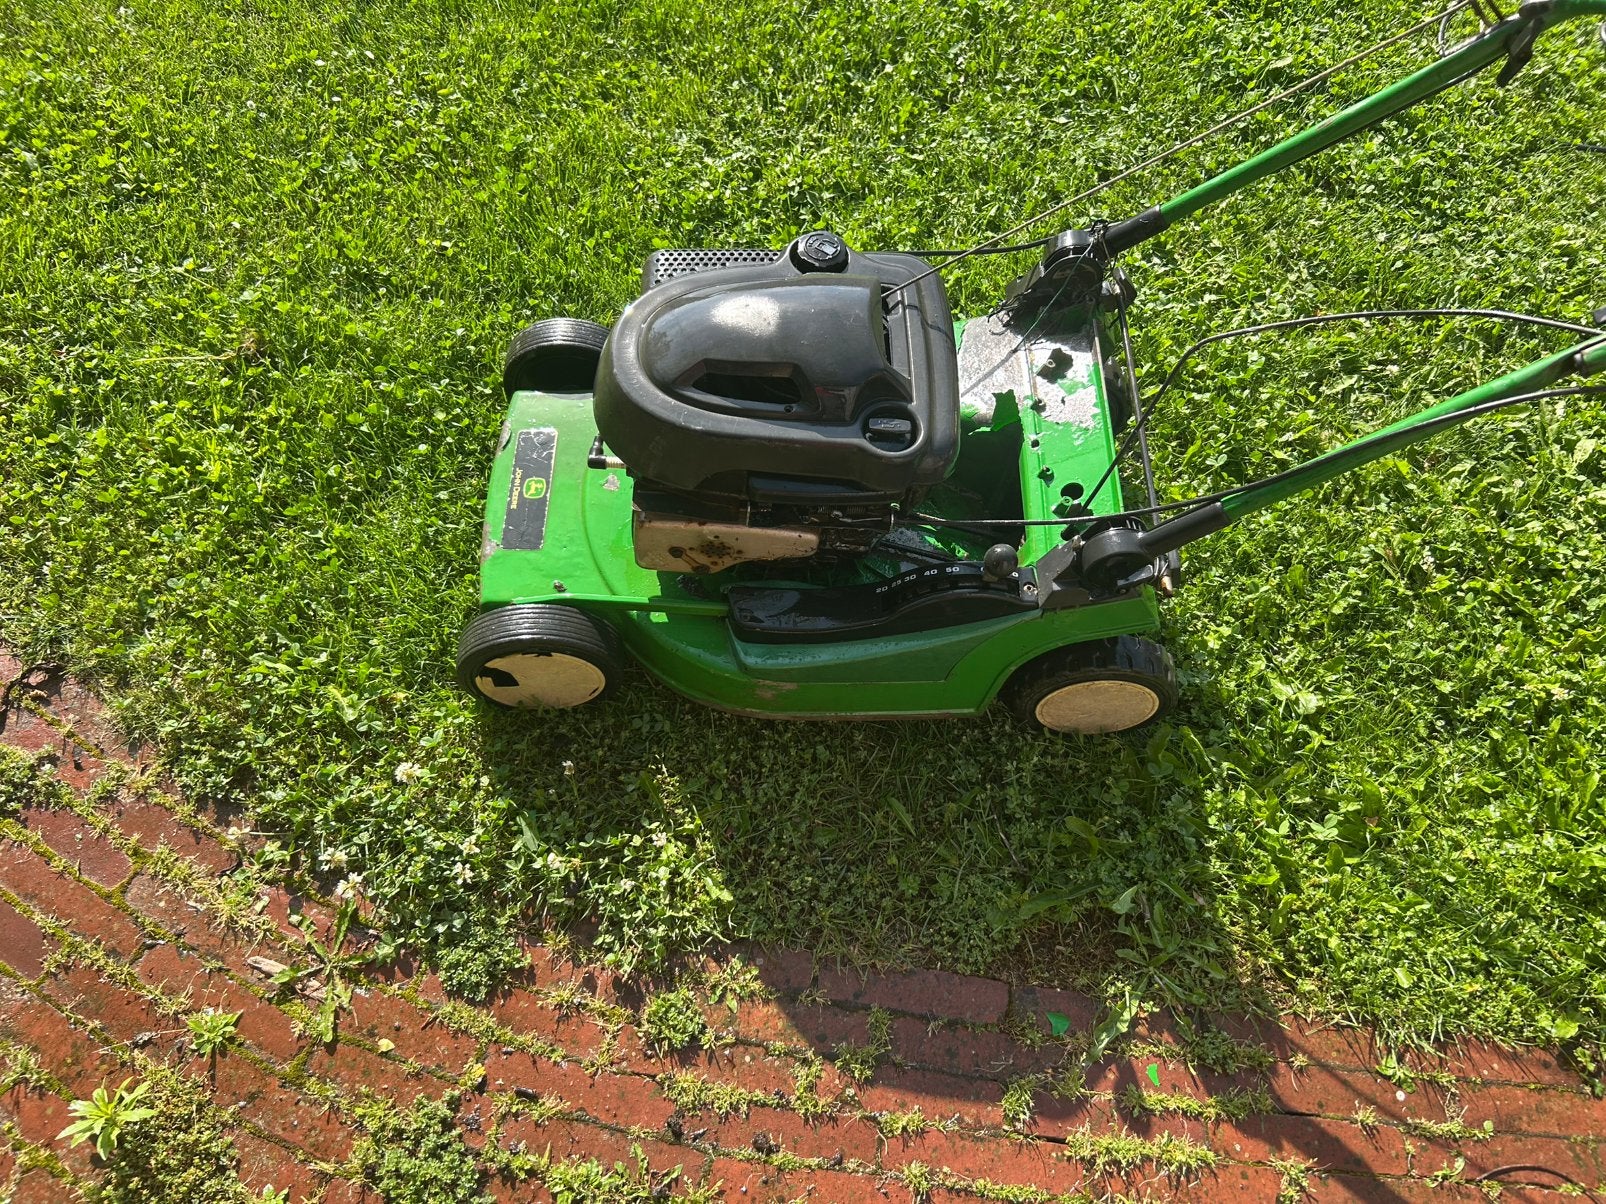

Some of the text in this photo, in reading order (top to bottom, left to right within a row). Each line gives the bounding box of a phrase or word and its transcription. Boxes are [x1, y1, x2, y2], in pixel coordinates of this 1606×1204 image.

[510, 467, 523, 509] JOHN DEERE
[891, 580, 902, 588] 25
[904, 574, 917, 582] 30
[945, 565, 960, 573] 50
